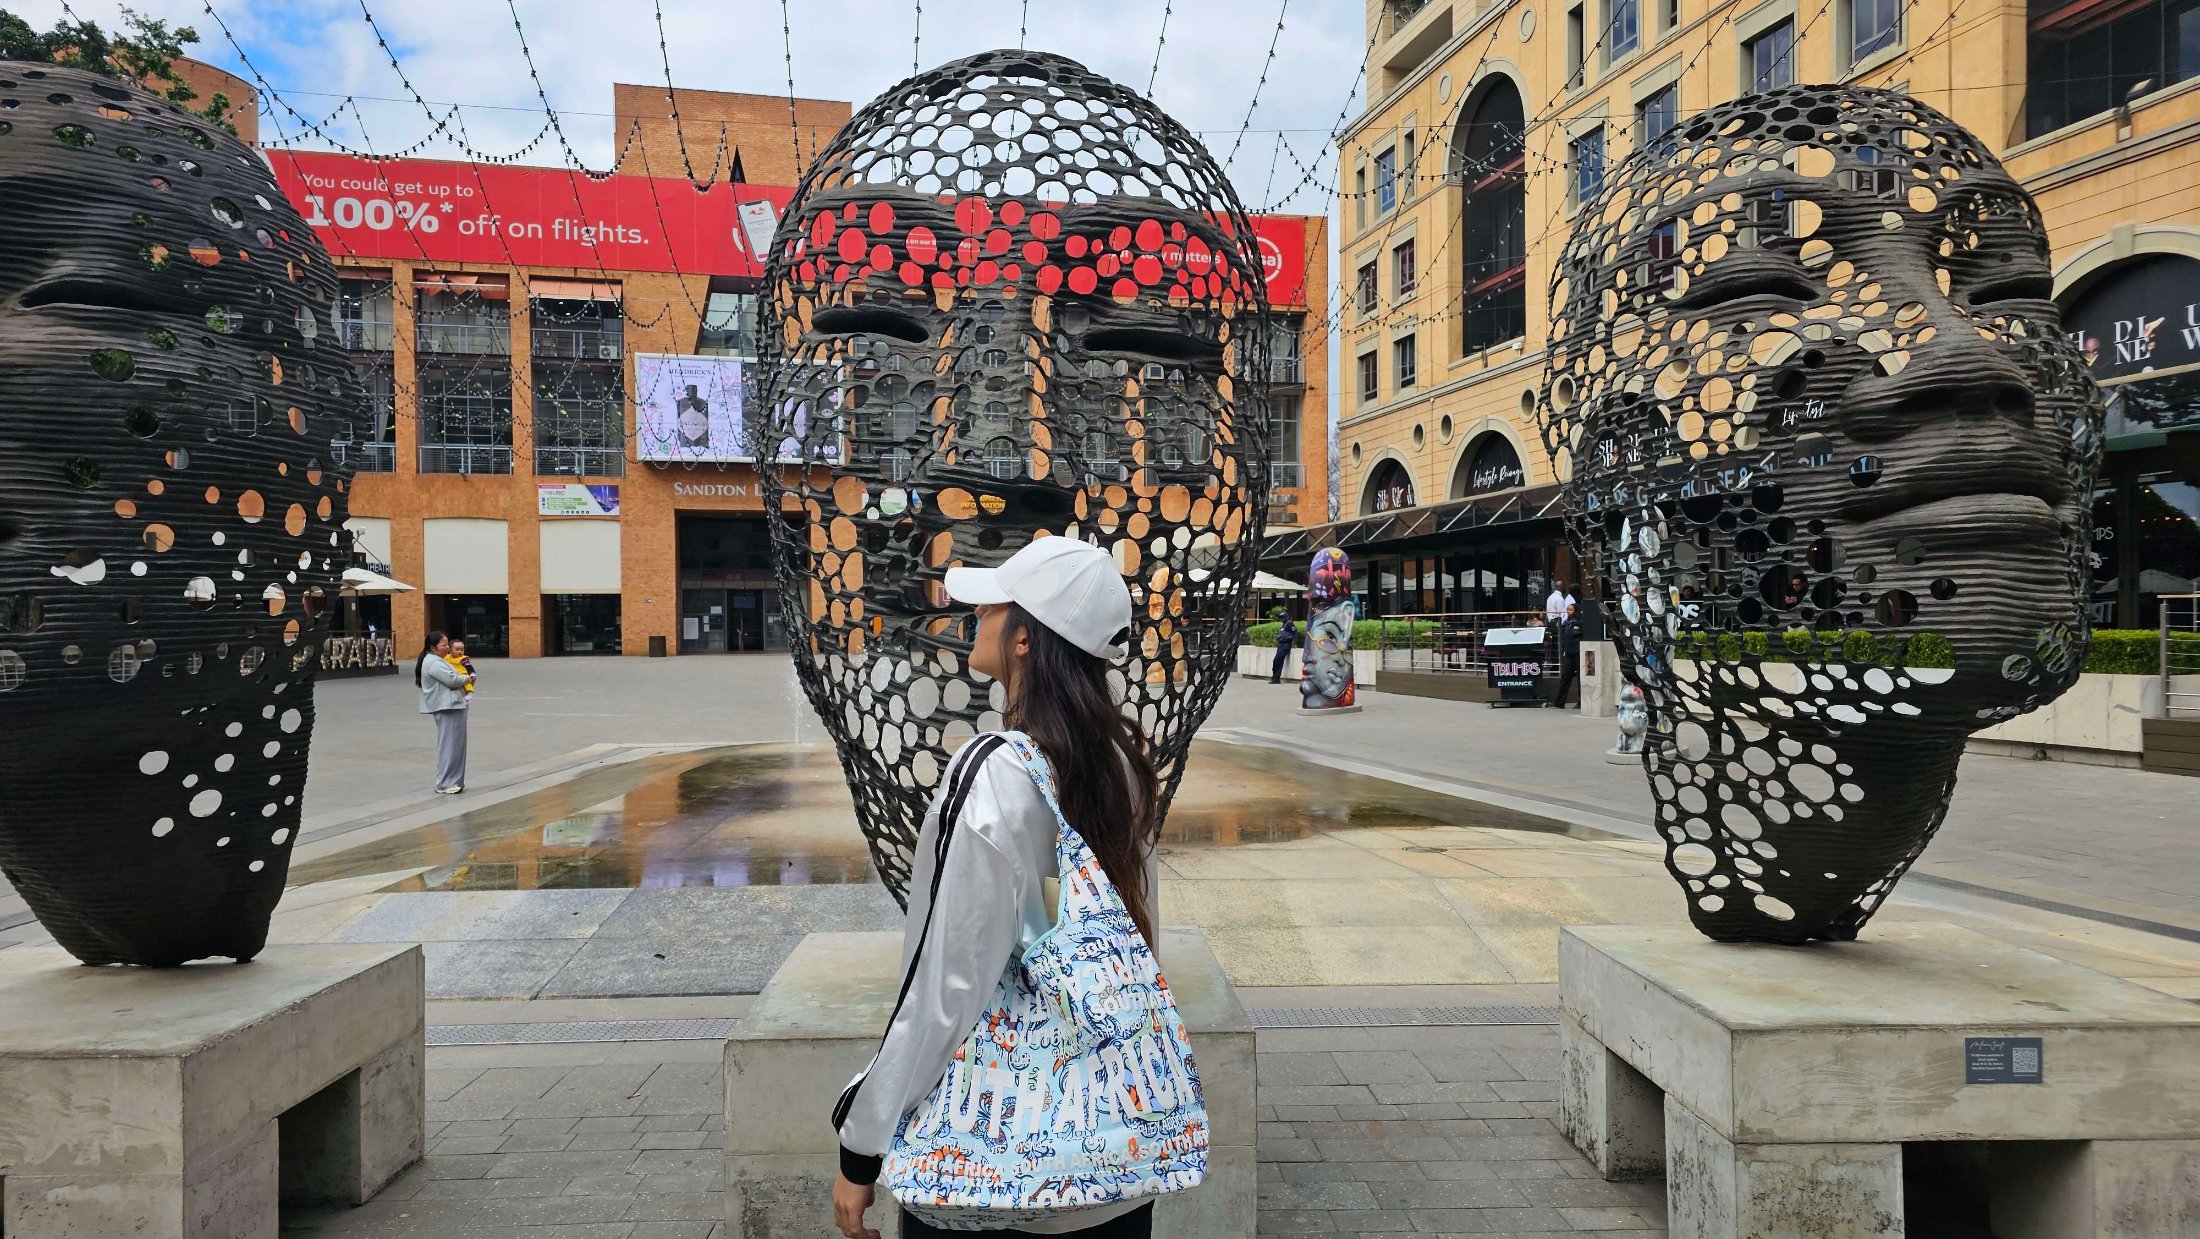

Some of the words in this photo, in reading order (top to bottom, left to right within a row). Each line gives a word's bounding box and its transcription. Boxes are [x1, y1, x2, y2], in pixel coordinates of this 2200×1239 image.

[301, 174, 335, 188] You
[340, 177, 390, 192] could
[394, 182, 424, 196] get
[428, 185, 450, 198] up
[456, 184, 474, 197] to
[458, 214, 502, 236] off
[508, 222, 543, 239] on
[551, 218, 649, 247] flights.
[673, 481, 746, 497] SANDTON
[1491, 662, 1541, 676] TRUMPS
[1052, 1033, 1196, 1134] AFRICA
